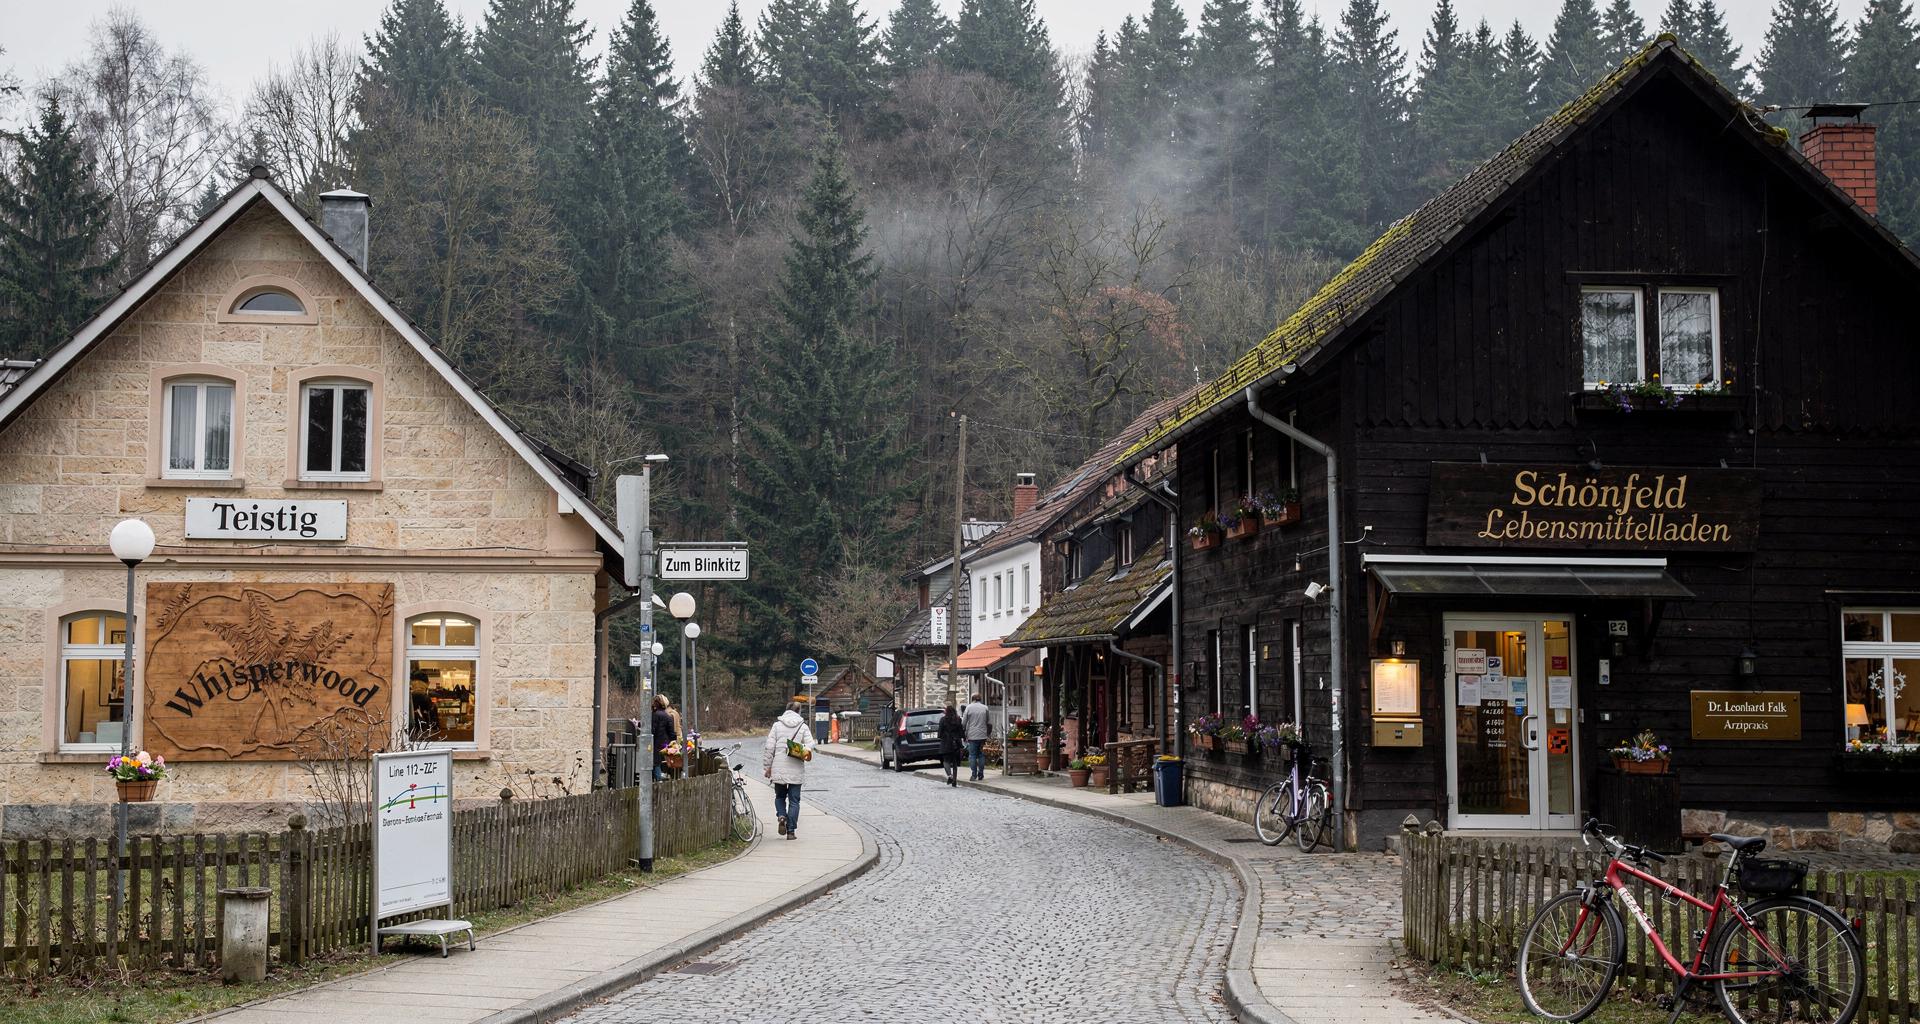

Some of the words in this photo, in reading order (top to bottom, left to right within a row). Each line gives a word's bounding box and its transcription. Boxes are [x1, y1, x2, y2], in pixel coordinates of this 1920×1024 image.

[1511, 470, 1687, 515] Schönfeld
[211, 502, 318, 538] Teistig
[1477, 508, 1732, 543] Lebensmittelladen
[665, 557, 691, 572] Zum
[695, 557, 741, 572] Blinkitz
[165, 658, 380, 719] Whisperwood
[1708, 701, 1723, 712] Dr.
[1767, 701, 1787, 713] Falk
[389, 765, 404, 778] Line
